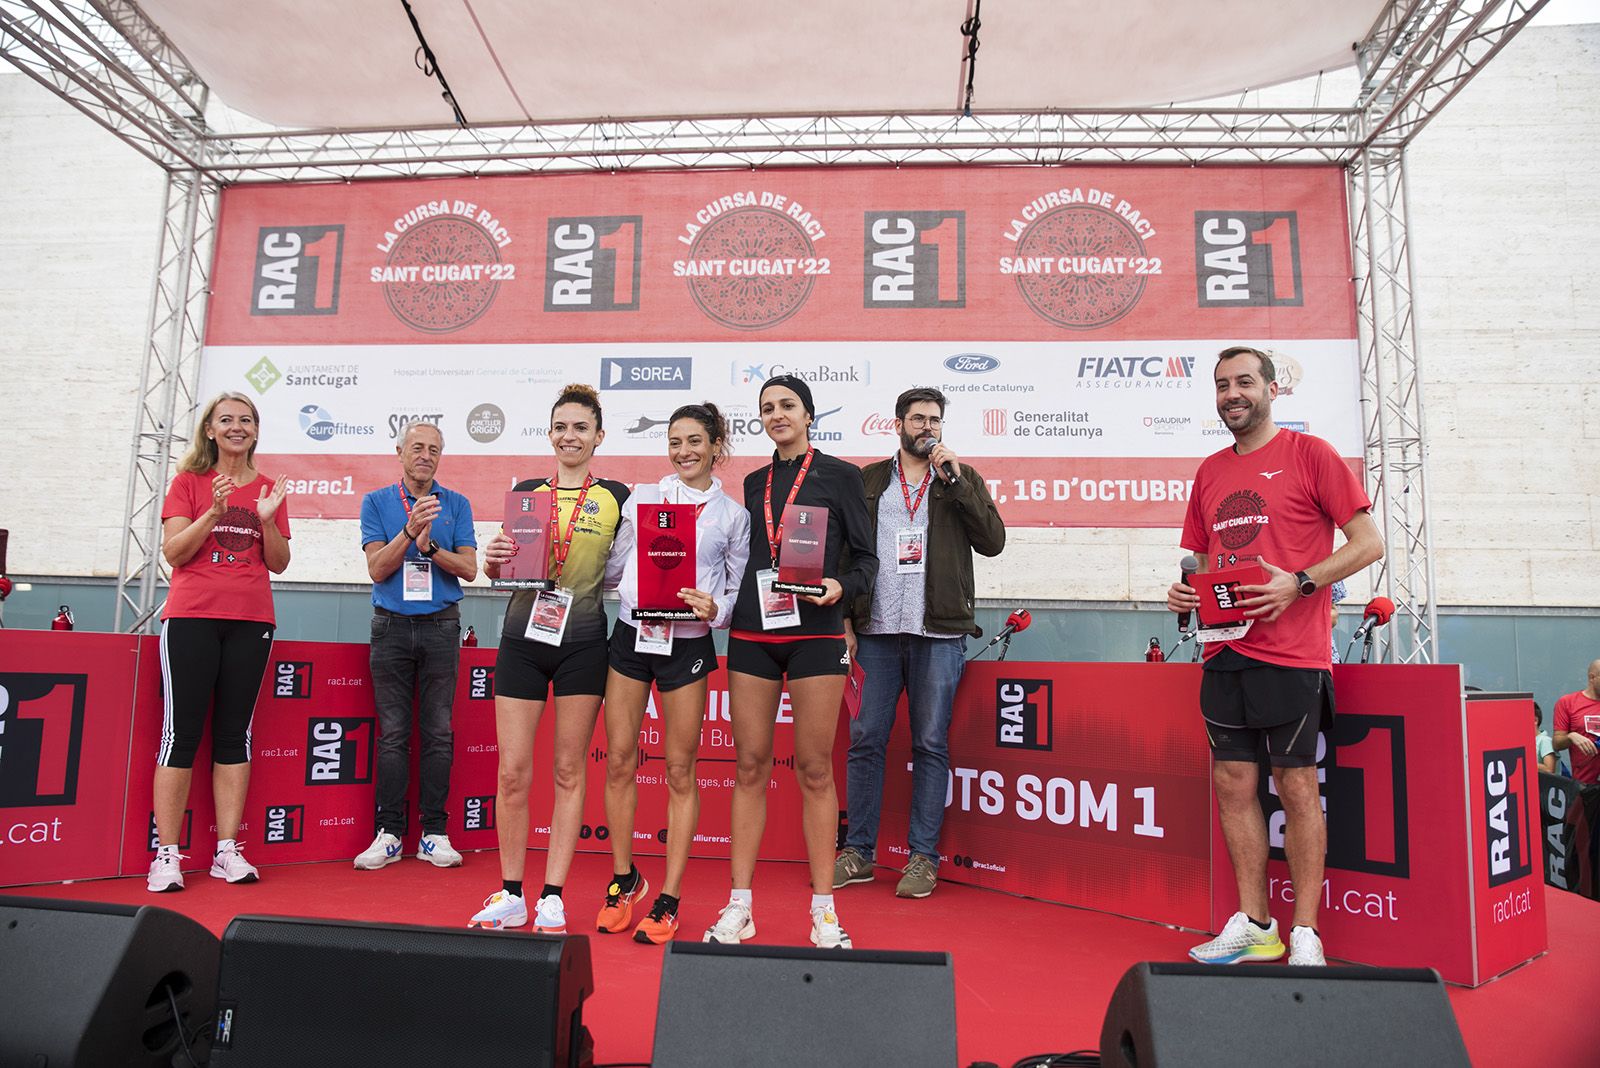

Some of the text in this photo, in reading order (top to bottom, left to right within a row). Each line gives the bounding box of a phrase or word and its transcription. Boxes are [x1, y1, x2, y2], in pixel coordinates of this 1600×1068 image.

[678, 190, 826, 245] LA CURSA DE RAC1
[1003, 187, 1157, 242] LA CURSA DE RAC1
[376, 200, 512, 253] LA CURSA DE RAC1
[552, 223, 595, 305] RAC
[673, 260, 726, 277] SANT
[729, 259, 797, 276] CUGAT
[872, 218, 915, 301] RAC
[999, 257, 1054, 274] SANT
[1058, 257, 1127, 274] CUGAT
[1202, 218, 1250, 300] RAC
[258, 232, 302, 309] RAC
[370, 266, 420, 282] SANT
[422, 264, 484, 282] CUGAT
[287, 364, 360, 374] AJUNTAMENT DE
[630, 366, 684, 382] SOREA
[955, 356, 990, 371] Ford
[285, 374, 359, 389] SantCugat
[942, 383, 966, 392] Ford
[967, 383, 981, 392] de
[982, 383, 1035, 394] Catalunya
[1076, 380, 1192, 389] ASSEGURANCES
[1013, 410, 1089, 423] Generalitat
[309, 422, 375, 436] eurofitness
[470, 425, 501, 434] ORIGEN
[1013, 425, 1103, 440] de Catalunya
[285, 475, 355, 495] sarac1
[1013, 479, 1046, 501] 16
[659, 512, 668, 528] RAC
[1228, 516, 1253, 527] CUGAT
[1213, 584, 1233, 609] RAC
[276, 663, 295, 696] RAC
[327, 677, 363, 686] rac1.cat
[471, 668, 488, 698] RAC
[1000, 683, 1025, 744] RAC
[261, 748, 298, 758] rac1.cat
[311, 721, 343, 780] RAC
[467, 744, 498, 753] rac1.cat
[466, 798, 481, 829] RAC
[1015, 773, 1118, 832] SOM
[1133, 786, 1164, 839] 1
[267, 808, 287, 842] RAC
[319, 816, 355, 826] rac1.cat
[1487, 759, 1511, 877] RAC
[0, 817, 62, 845] .cat
[1547, 786, 1569, 890] RAC
[1269, 877, 1398, 921] ra1.cat
[1492, 887, 1532, 924] rac1.cat
